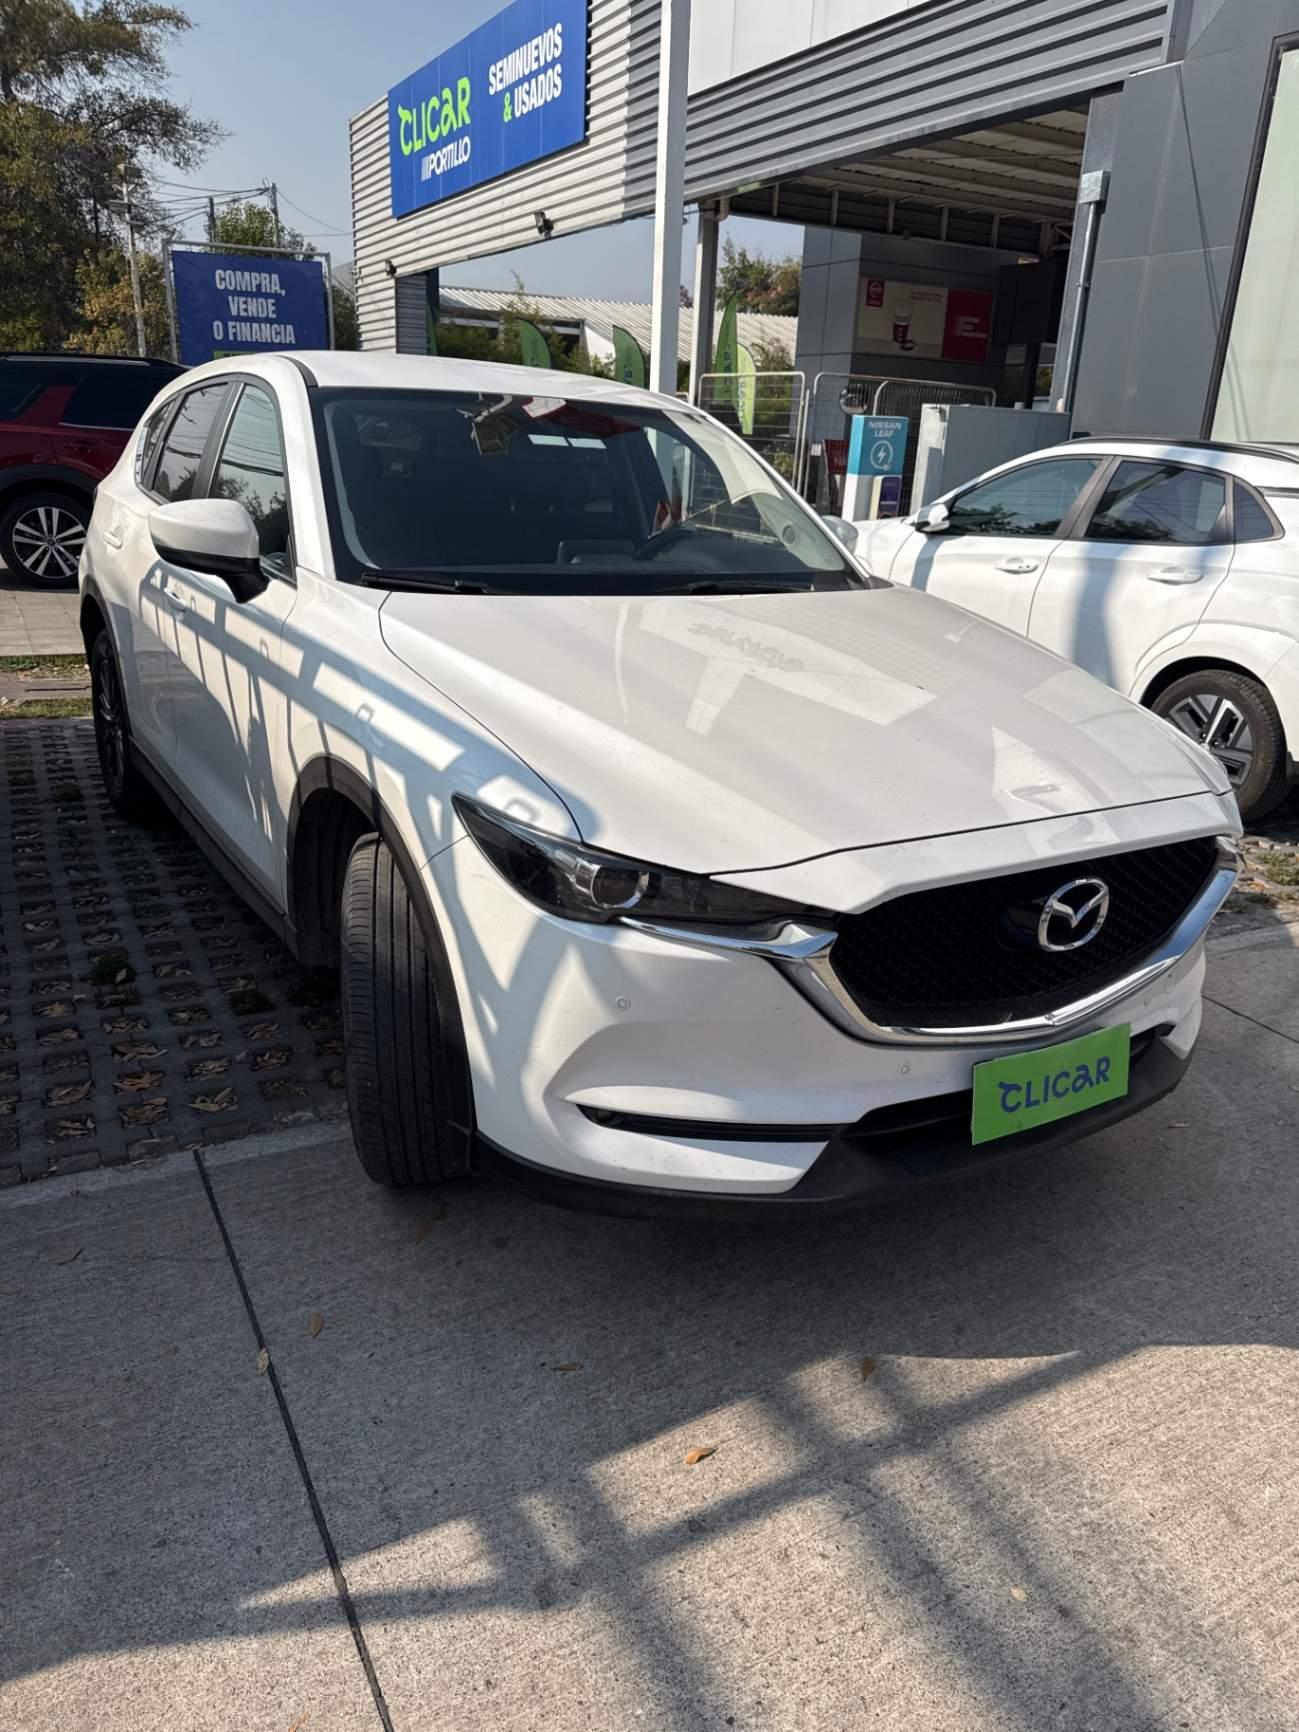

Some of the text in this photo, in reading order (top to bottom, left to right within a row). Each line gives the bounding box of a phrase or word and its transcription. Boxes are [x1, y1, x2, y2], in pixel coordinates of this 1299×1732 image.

[489, 23, 562, 95] SEMINUEVOS
[503, 64, 562, 122] & USADOS
[428, 136, 470, 179] PORTILLO
[215, 269, 286, 296] COMPRA,
[228, 296, 277, 318] VENDE
[213, 321, 296, 344] O FINANCIA
[868, 421, 902, 429] NISSAN
[874, 429, 894, 437] LEAF
